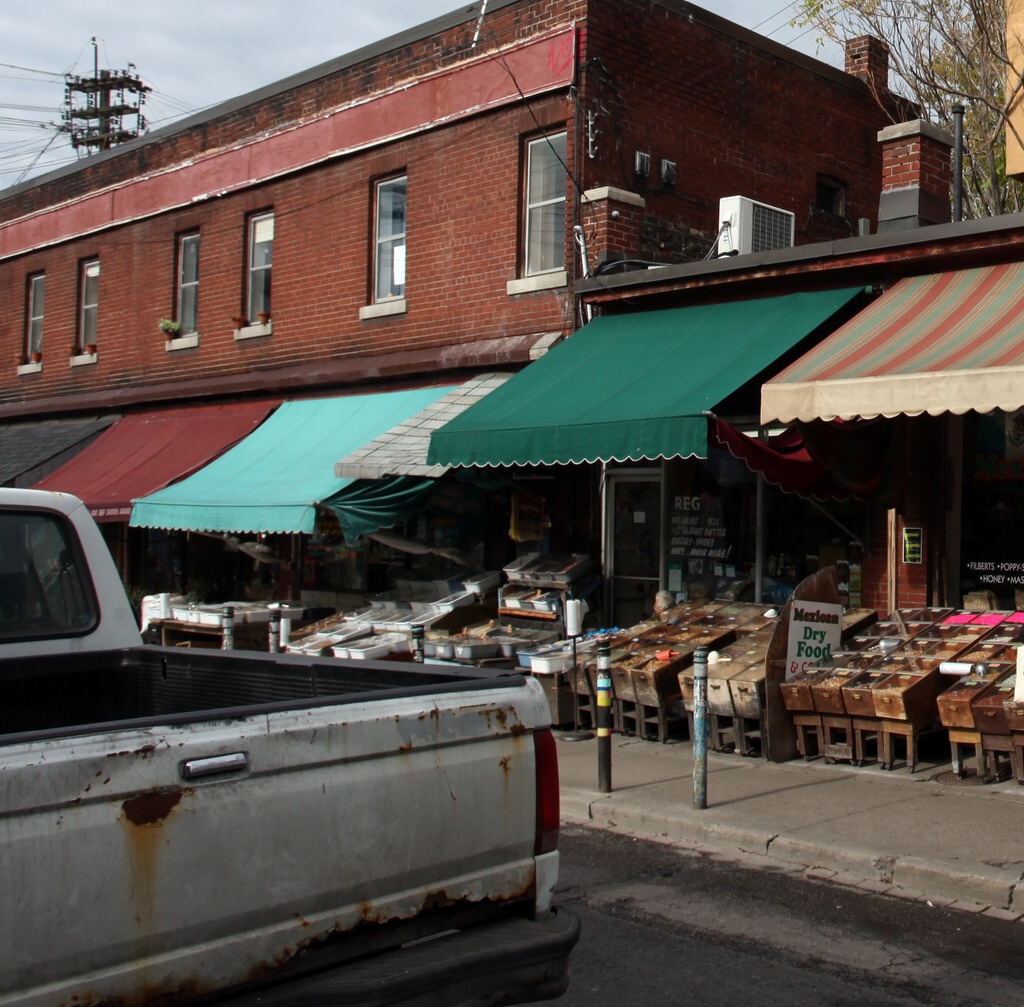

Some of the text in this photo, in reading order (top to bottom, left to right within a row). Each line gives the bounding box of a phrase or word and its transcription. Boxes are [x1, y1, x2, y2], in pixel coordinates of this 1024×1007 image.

[674, 496, 700, 510] REG
[969, 562, 995, 571] FILBERTS
[983, 575, 1005, 584] HONEY
[793, 607, 839, 625] Mexican
[803, 626, 827, 644] Dry
[796, 641, 831, 659] Food
